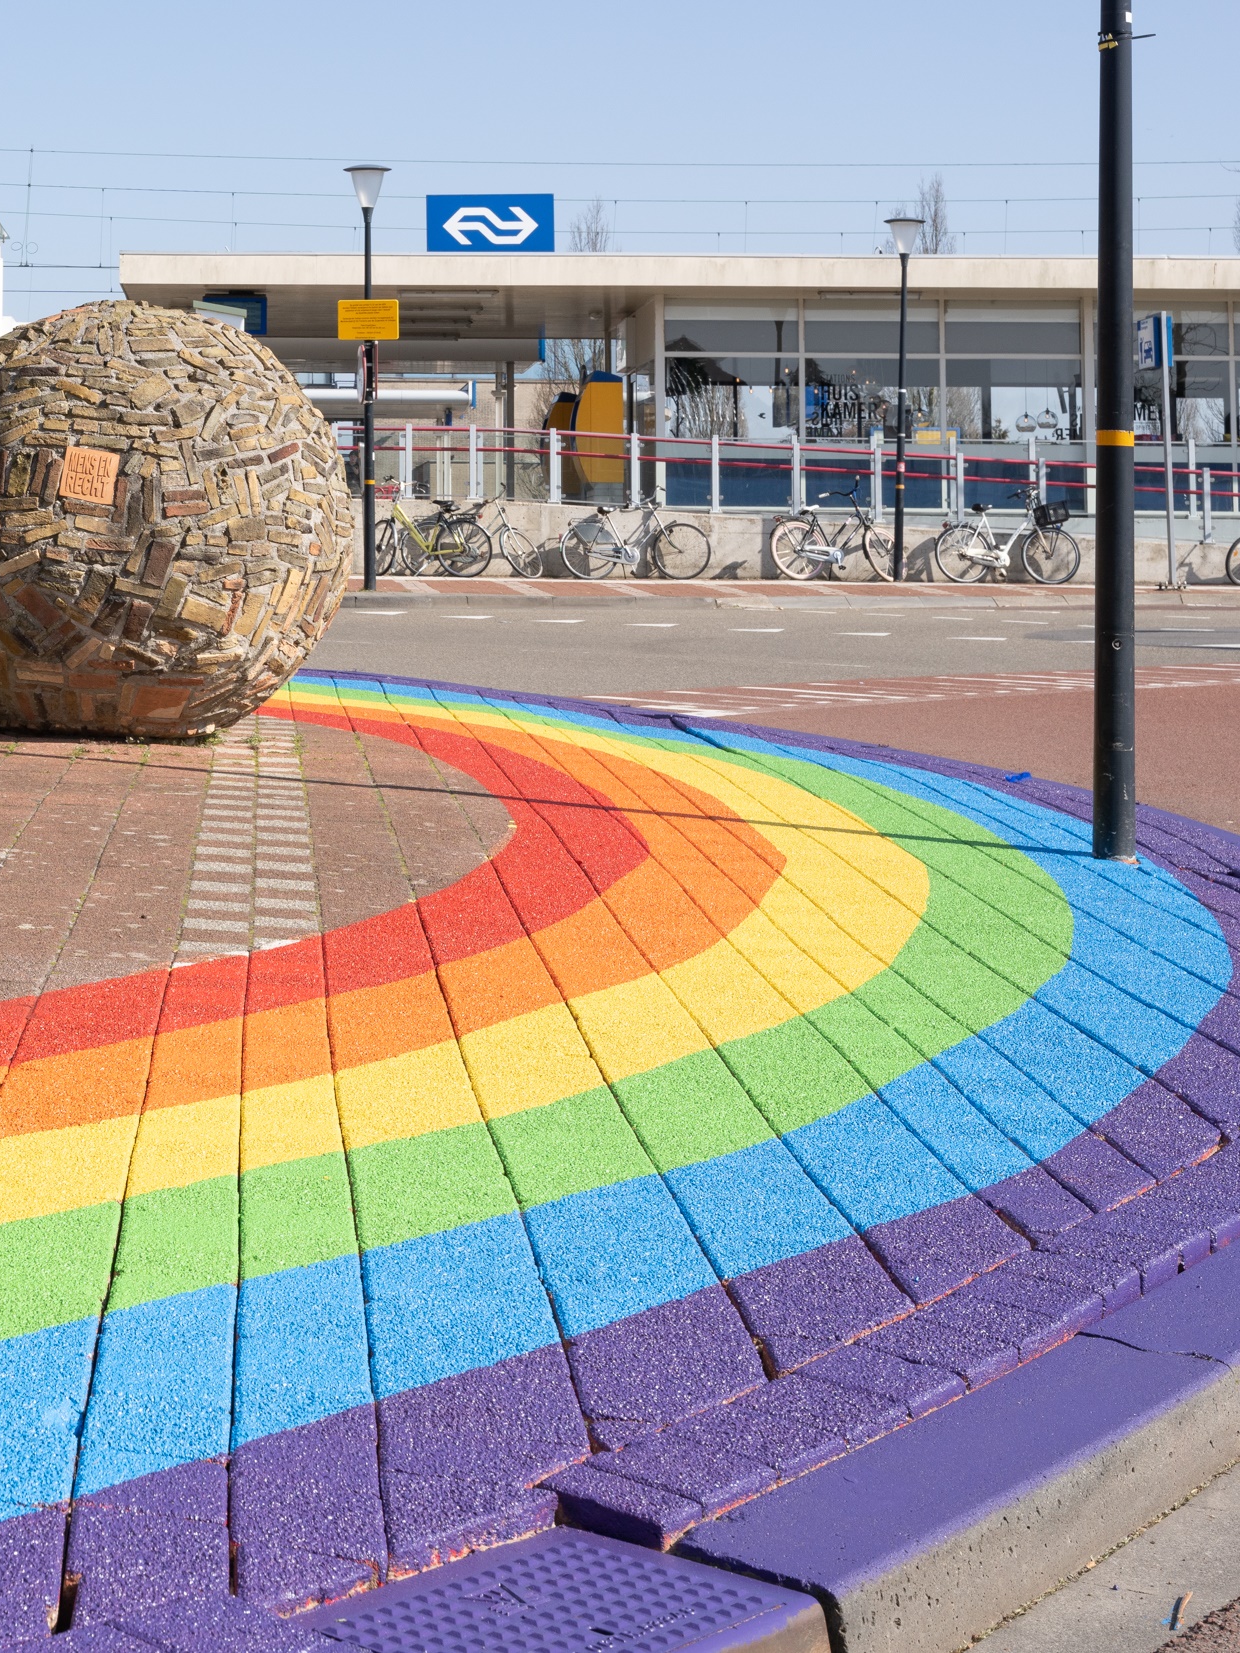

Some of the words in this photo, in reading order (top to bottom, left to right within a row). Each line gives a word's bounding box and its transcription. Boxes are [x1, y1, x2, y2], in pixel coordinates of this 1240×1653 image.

[822, 373, 856, 384] TATIONS
[821, 384, 859, 401] HUIS
[821, 402, 878, 419] KAMER
[68, 452, 97, 475] MENS
[97, 456, 112, 478] EN
[65, 472, 109, 498] RECHT
